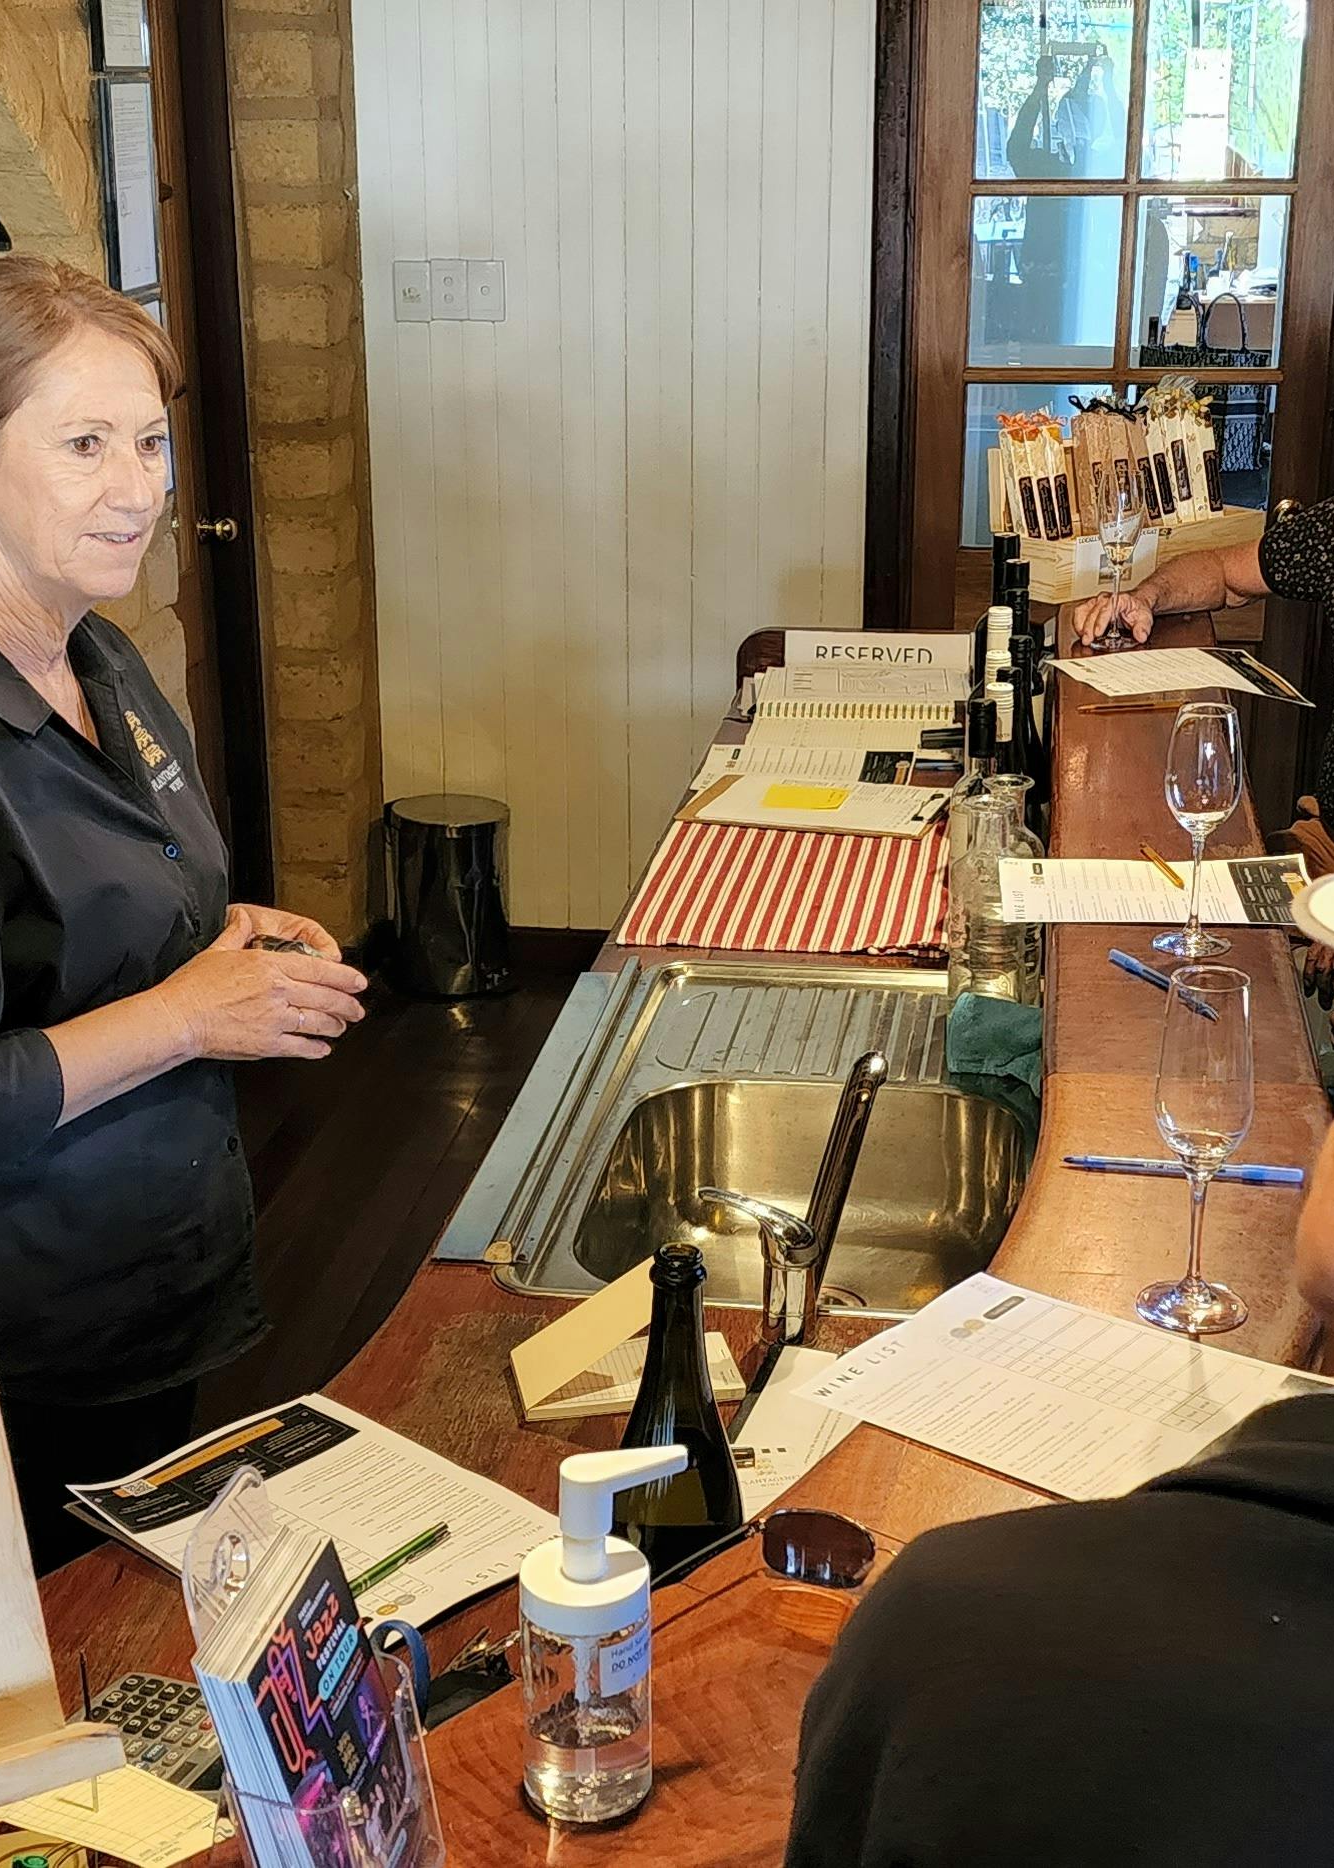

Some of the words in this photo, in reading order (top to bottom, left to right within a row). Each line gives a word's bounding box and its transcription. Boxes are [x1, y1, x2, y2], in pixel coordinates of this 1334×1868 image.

[812, 1365, 865, 1398] WINE
[867, 1339, 907, 1366] LIST
[465, 1561, 510, 1587] LIST
[305, 1592, 341, 1661] Jazz
[316, 1619, 347, 1673] FESTIVAL
[322, 1668, 337, 1692] ON
[335, 1632, 356, 1676] TOUR
[144, 1682, 157, 1690] 1
[163, 1686, 176, 1695] 4
[104, 1691, 124, 1703] 00
[185, 1690, 197, 1699] 7
[126, 1697, 140, 1706] 2
[147, 1702, 160, 1711] 5
[165, 1706, 180, 1716] 8
[109, 1714, 123, 1722] 3
[128, 1718, 142, 1727] 6
[148, 1723, 162, 1732] 9
